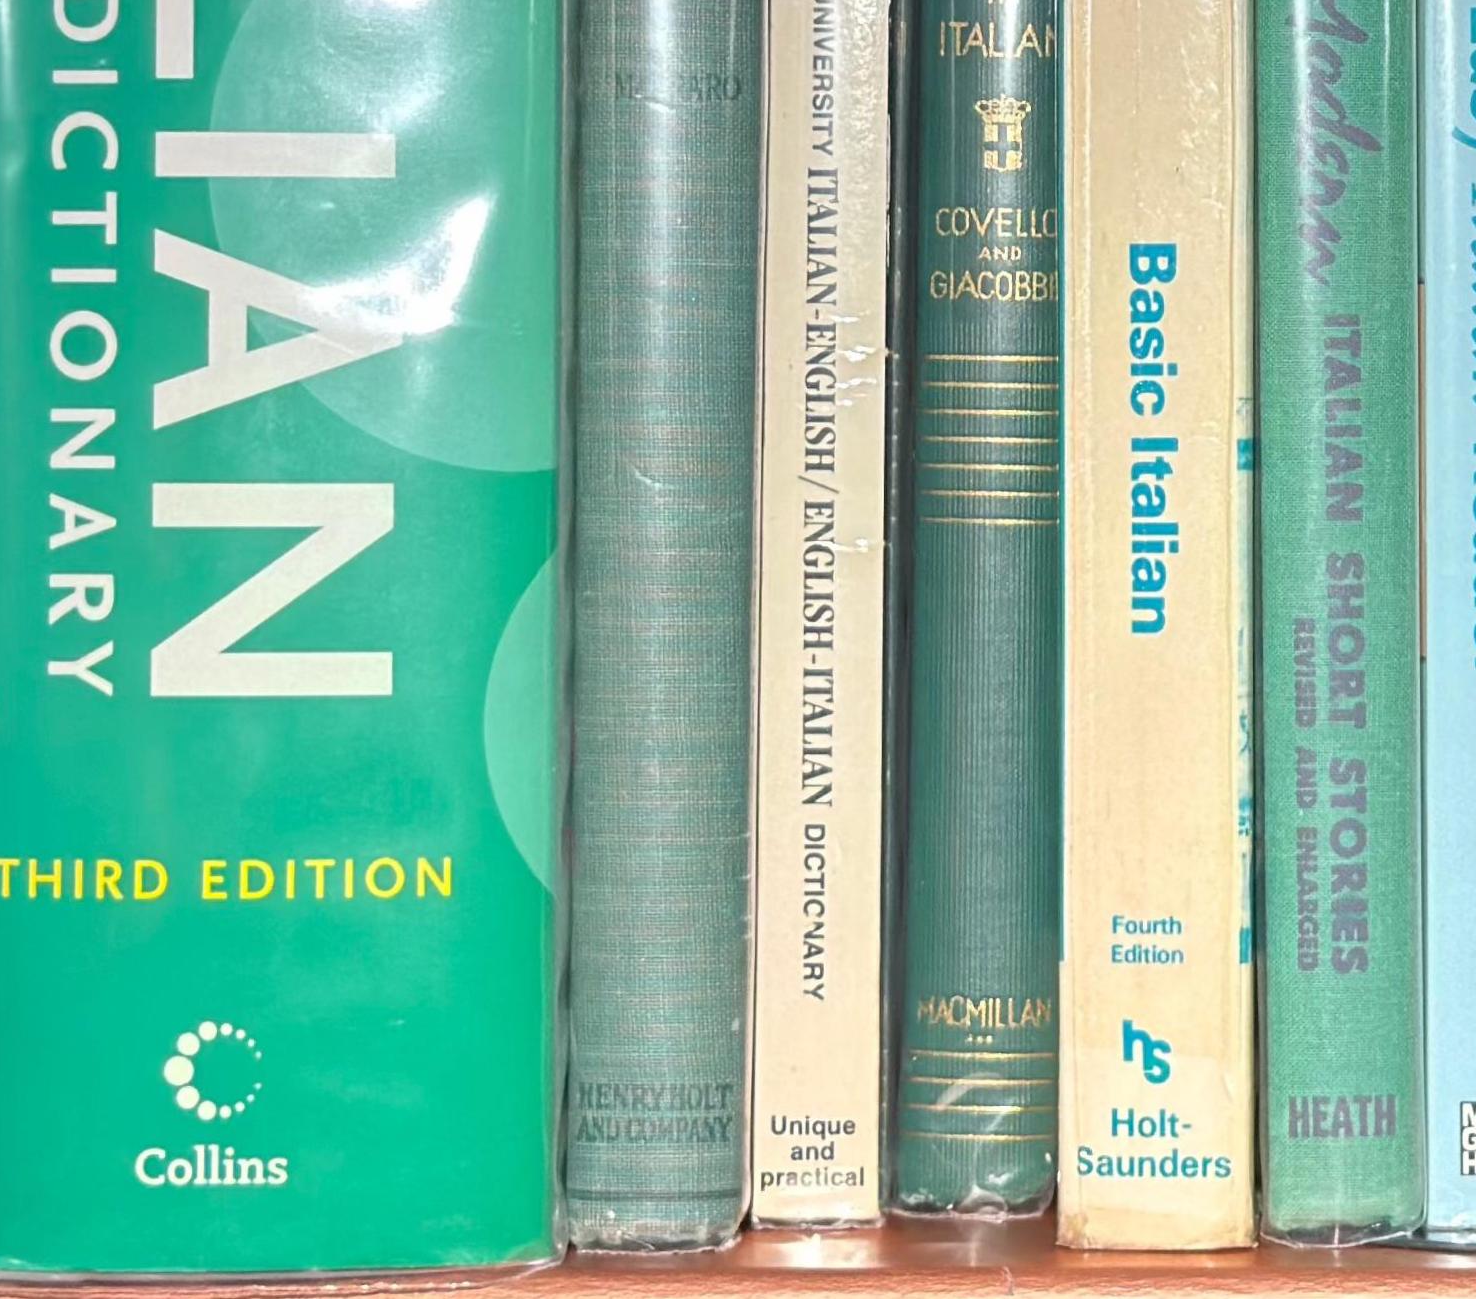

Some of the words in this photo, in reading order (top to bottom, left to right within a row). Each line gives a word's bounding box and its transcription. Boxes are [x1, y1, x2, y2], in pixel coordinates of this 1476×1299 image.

[940, 21, 1055, 58] ITALAN
[978, 245, 1022, 261] AND
[1129, 243, 1178, 417] Basic
[1323, 314, 1365, 521] ITALIAN
[1130, 437, 1180, 634] Italian
[1325, 551, 1367, 730] SHORT
[1293, 617, 1317, 729] REVISED
[1294, 746, 1319, 809] AND
[201, 856, 453, 900] EDITION
[1329, 757, 1370, 975] STORIES
[802, 824, 826, 1001] DICTIONARY
[1296, 826, 1320, 972] ENLARGED
[1111, 915, 1183, 935] Fourth
[1111, 944, 1184, 964] Edition
[918, 995, 1053, 1029] MACMILLAN
[771, 1116, 856, 1138] Unique
[1111, 1108, 1193, 1138] Holt-
[1288, 1094, 1396, 1139] HEATH
[134, 1144, 289, 1187] Collins
[790, 1142, 835, 1161] and
[1077, 1146, 1232, 1177] Saunders
[760, 1166, 865, 1191] practical
